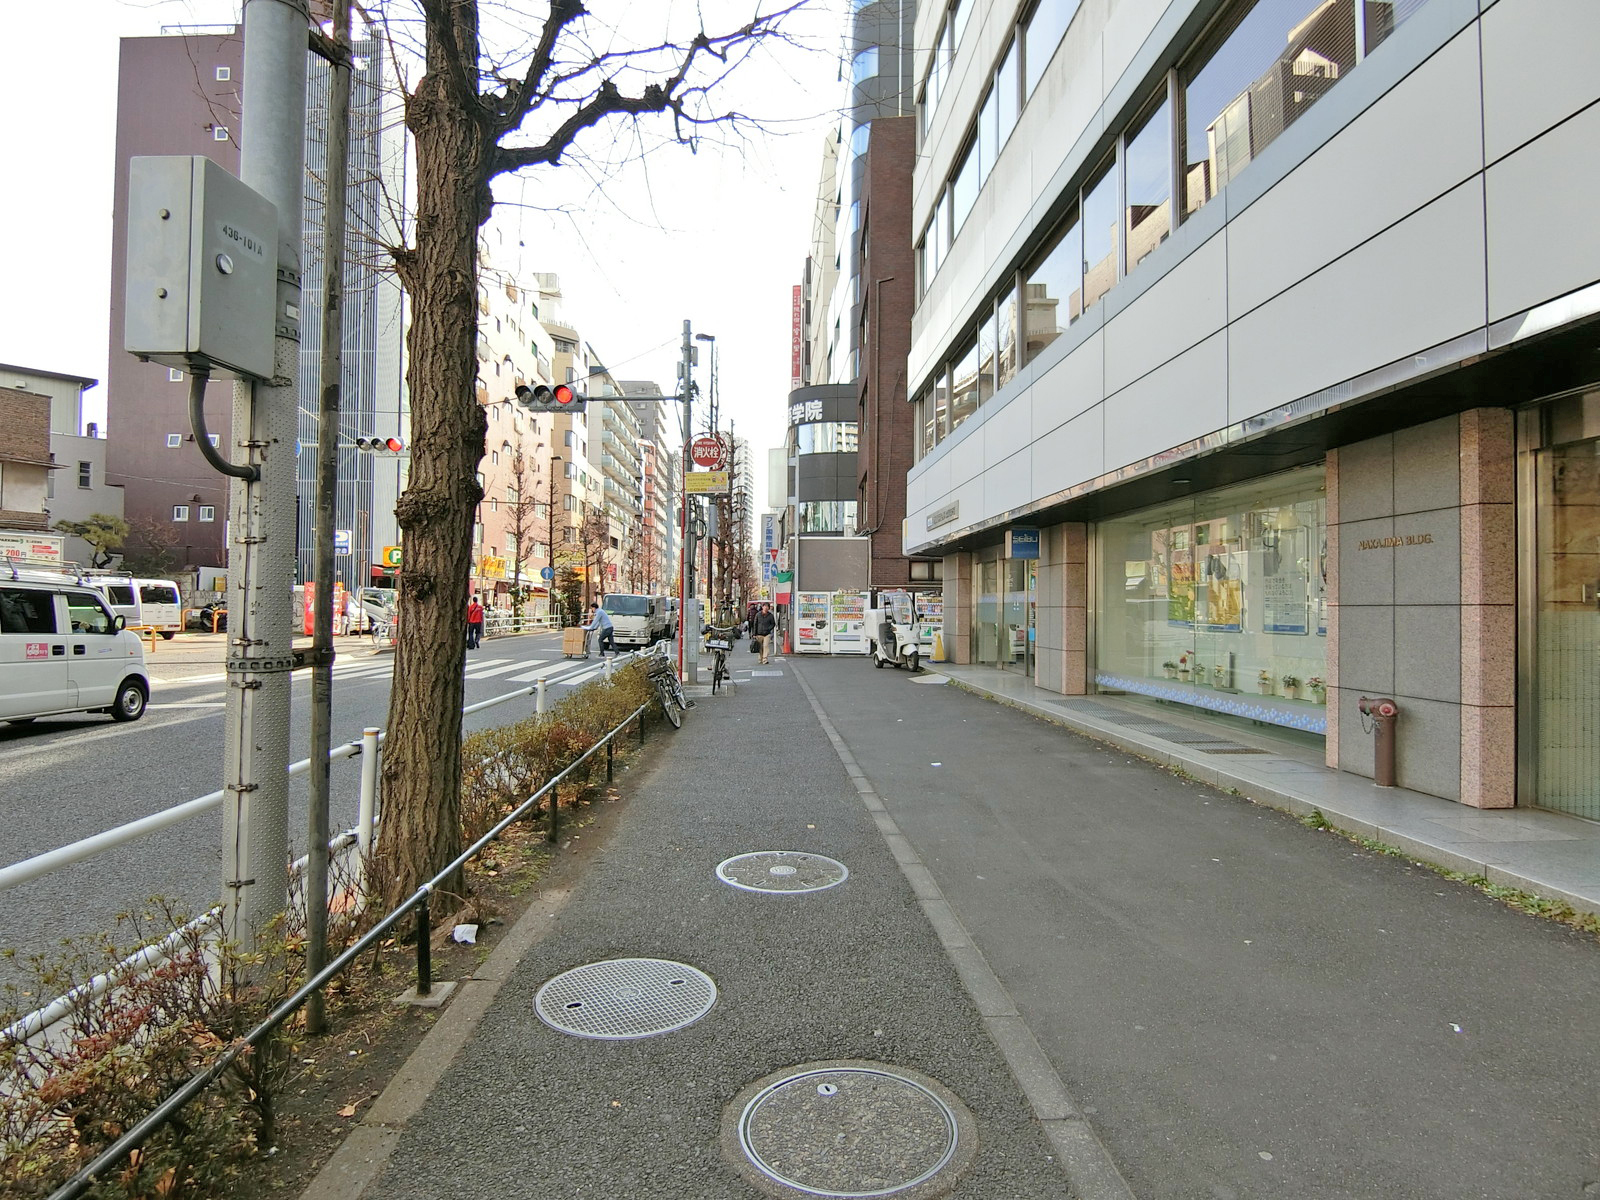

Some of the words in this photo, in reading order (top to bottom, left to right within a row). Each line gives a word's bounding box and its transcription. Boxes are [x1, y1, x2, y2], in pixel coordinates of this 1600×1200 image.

[694, 446, 719, 459] 消火栓
[1358, 536, 1403, 551] NAKAJIMA
[1406, 533, 1434, 546] BLDG.
